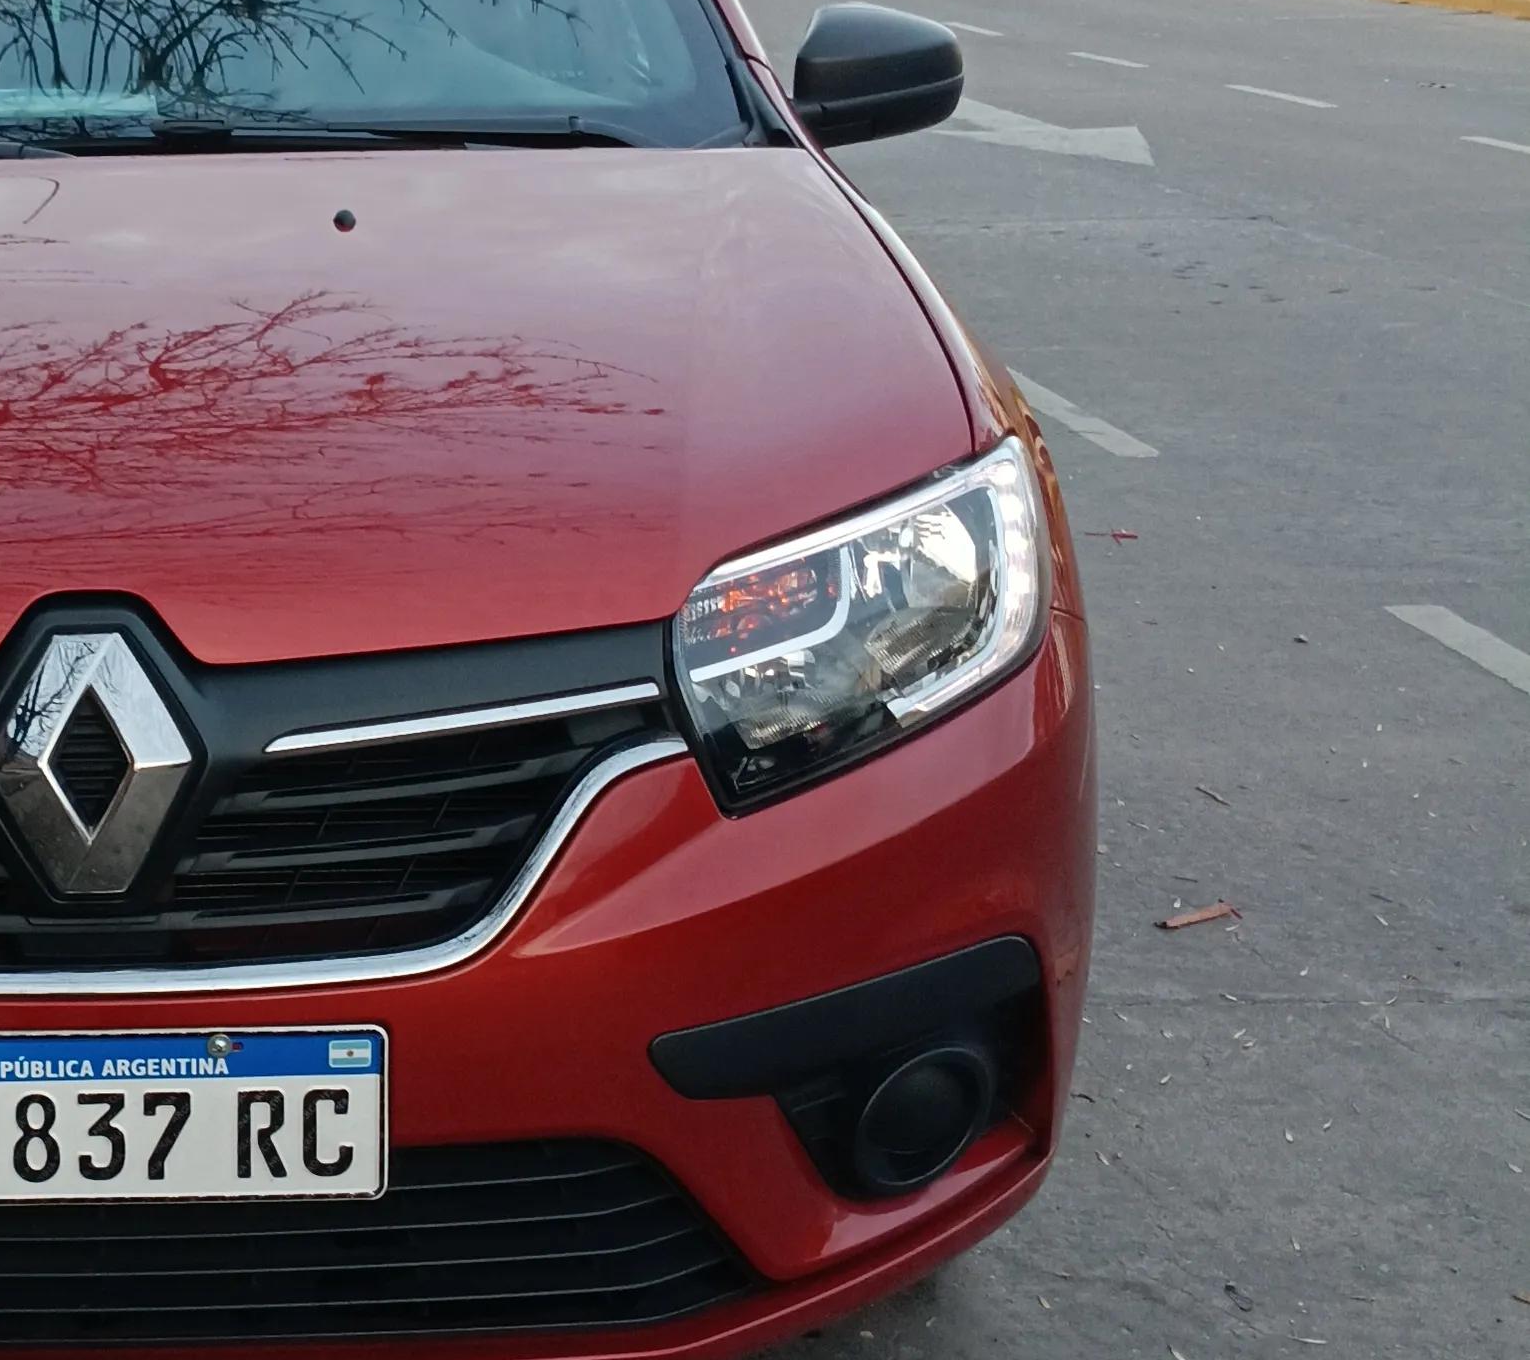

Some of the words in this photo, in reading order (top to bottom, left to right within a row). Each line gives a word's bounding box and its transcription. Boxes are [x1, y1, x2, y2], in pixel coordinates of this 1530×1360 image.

[101, 1058, 230, 1077] ARGENTINA
[13, 1091, 192, 1183] 837
[237, 1088, 354, 1179] RC
